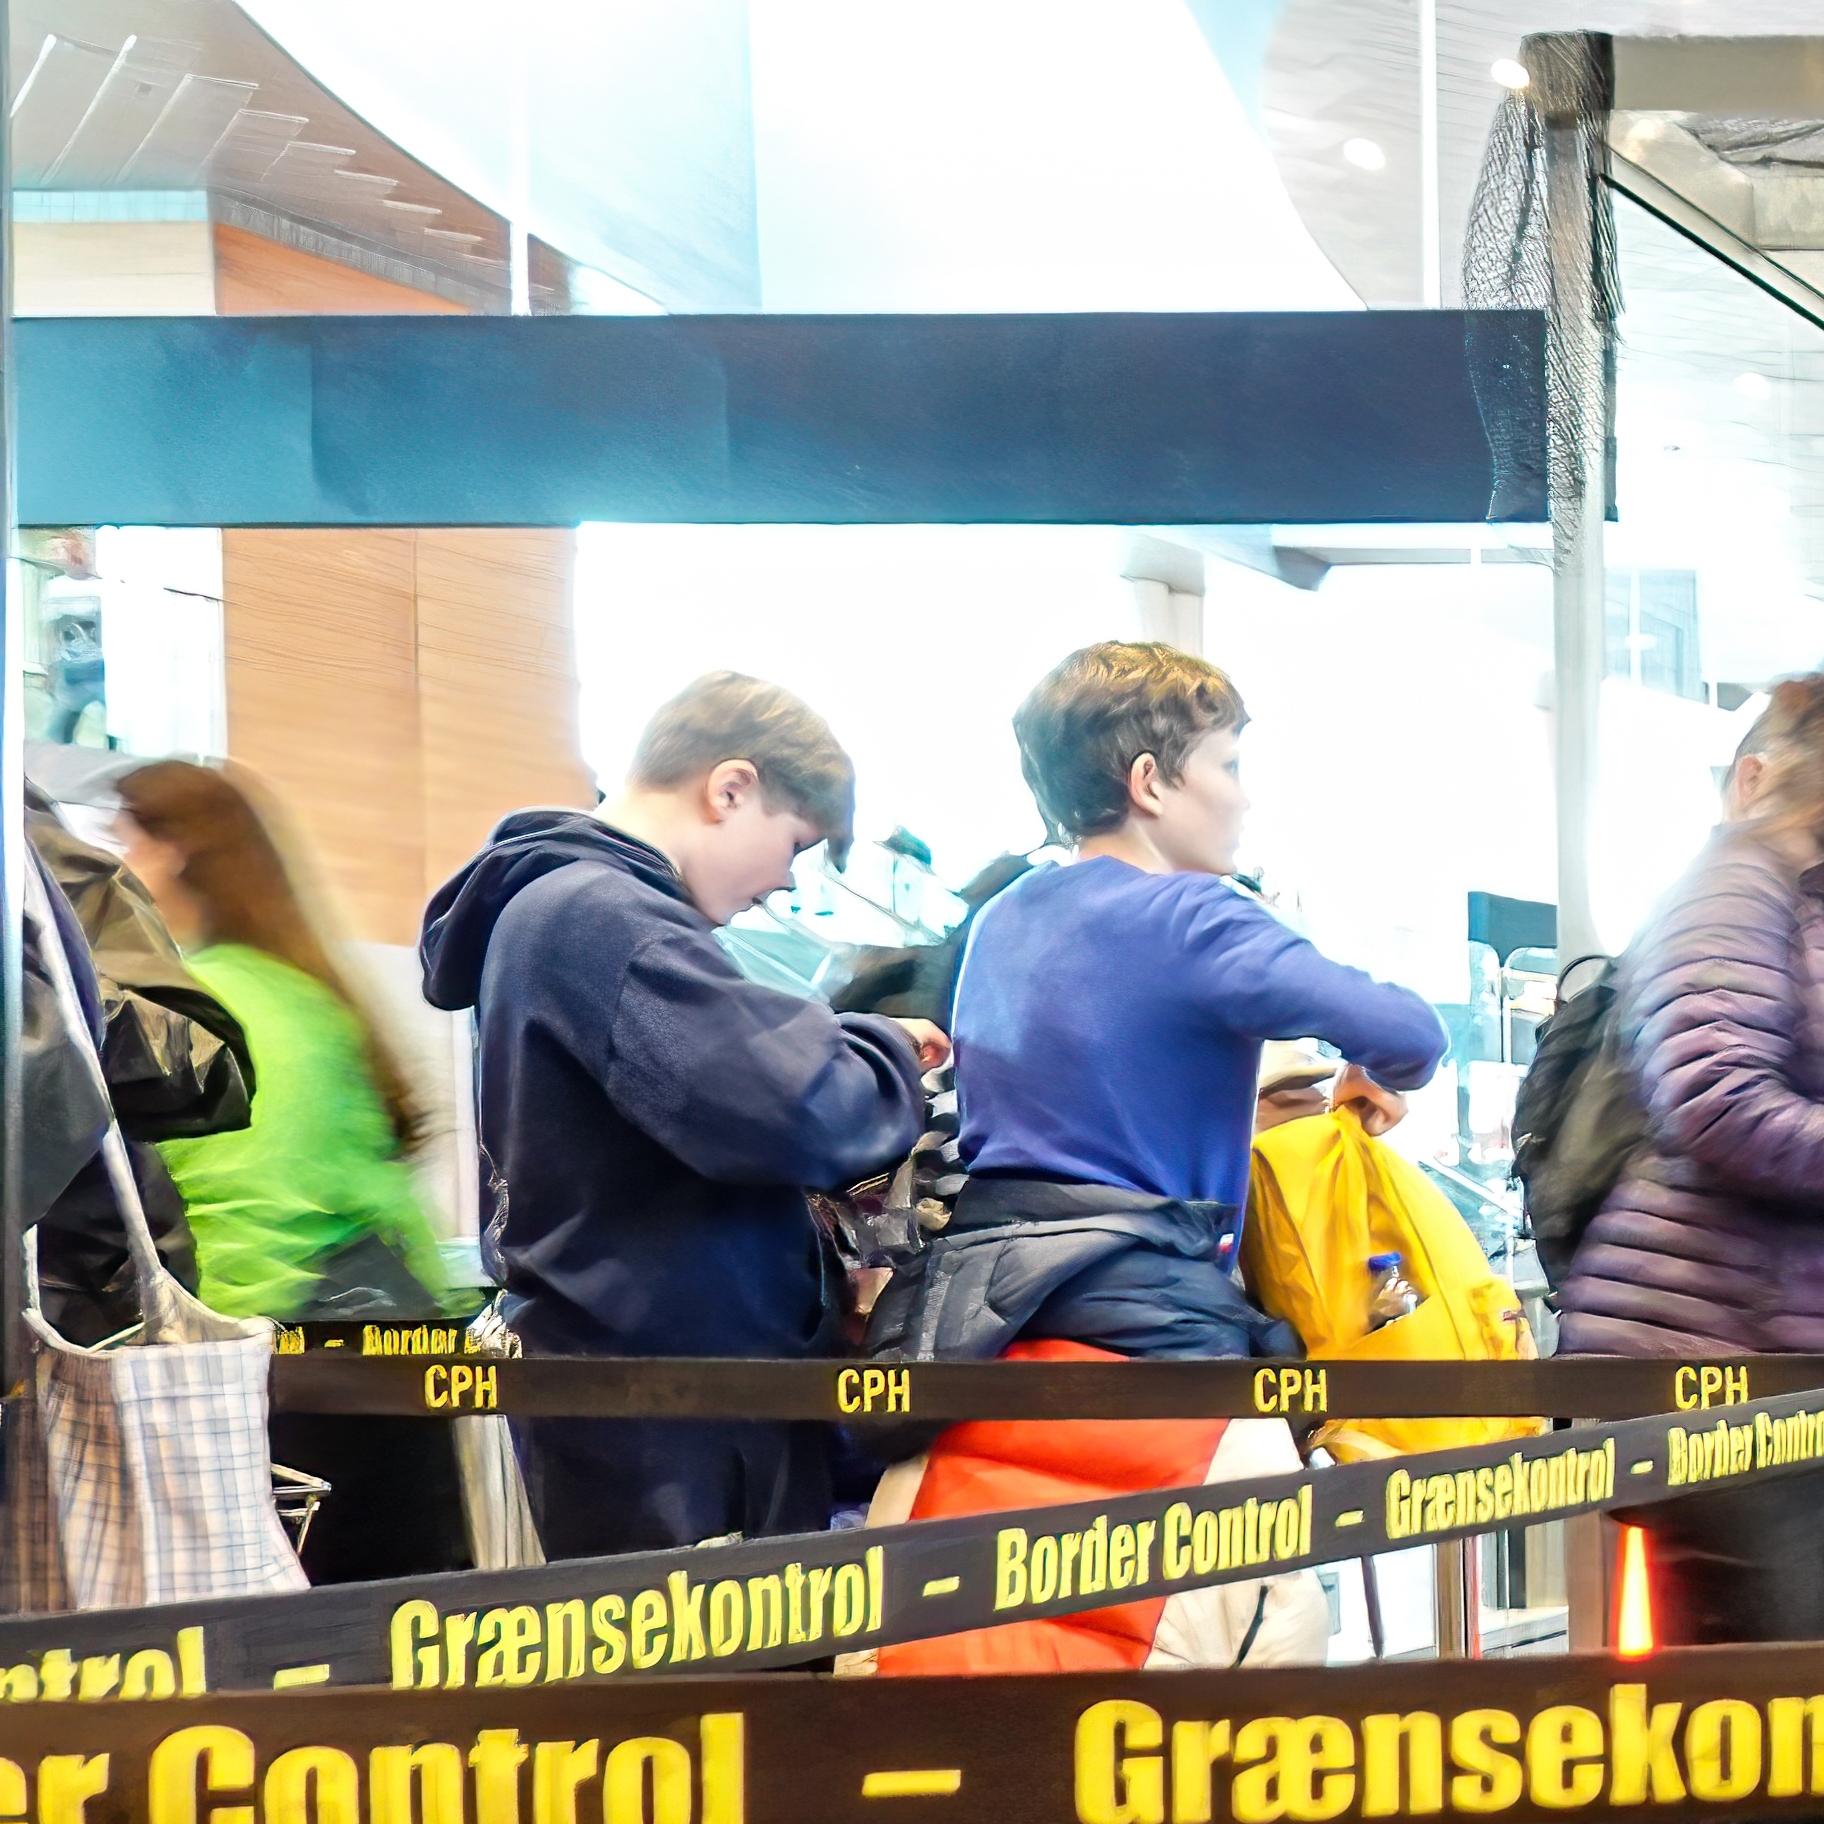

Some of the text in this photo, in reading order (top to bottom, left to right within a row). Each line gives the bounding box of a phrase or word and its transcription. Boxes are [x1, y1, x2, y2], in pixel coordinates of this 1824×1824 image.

[423, 1364, 498, 1409] CPH
[837, 1368, 912, 1414] CPH
[1253, 1367, 1327, 1414] CPH
[1674, 1365, 1750, 1412] CPH
[390, 1544, 884, 1692] Grænsekontrol
[993, 1514, 1157, 1612] Border
[1161, 1484, 1314, 1582] Control
[1384, 1438, 1616, 1540] Grænsekontrol
[1667, 1419, 1754, 1487] Border
